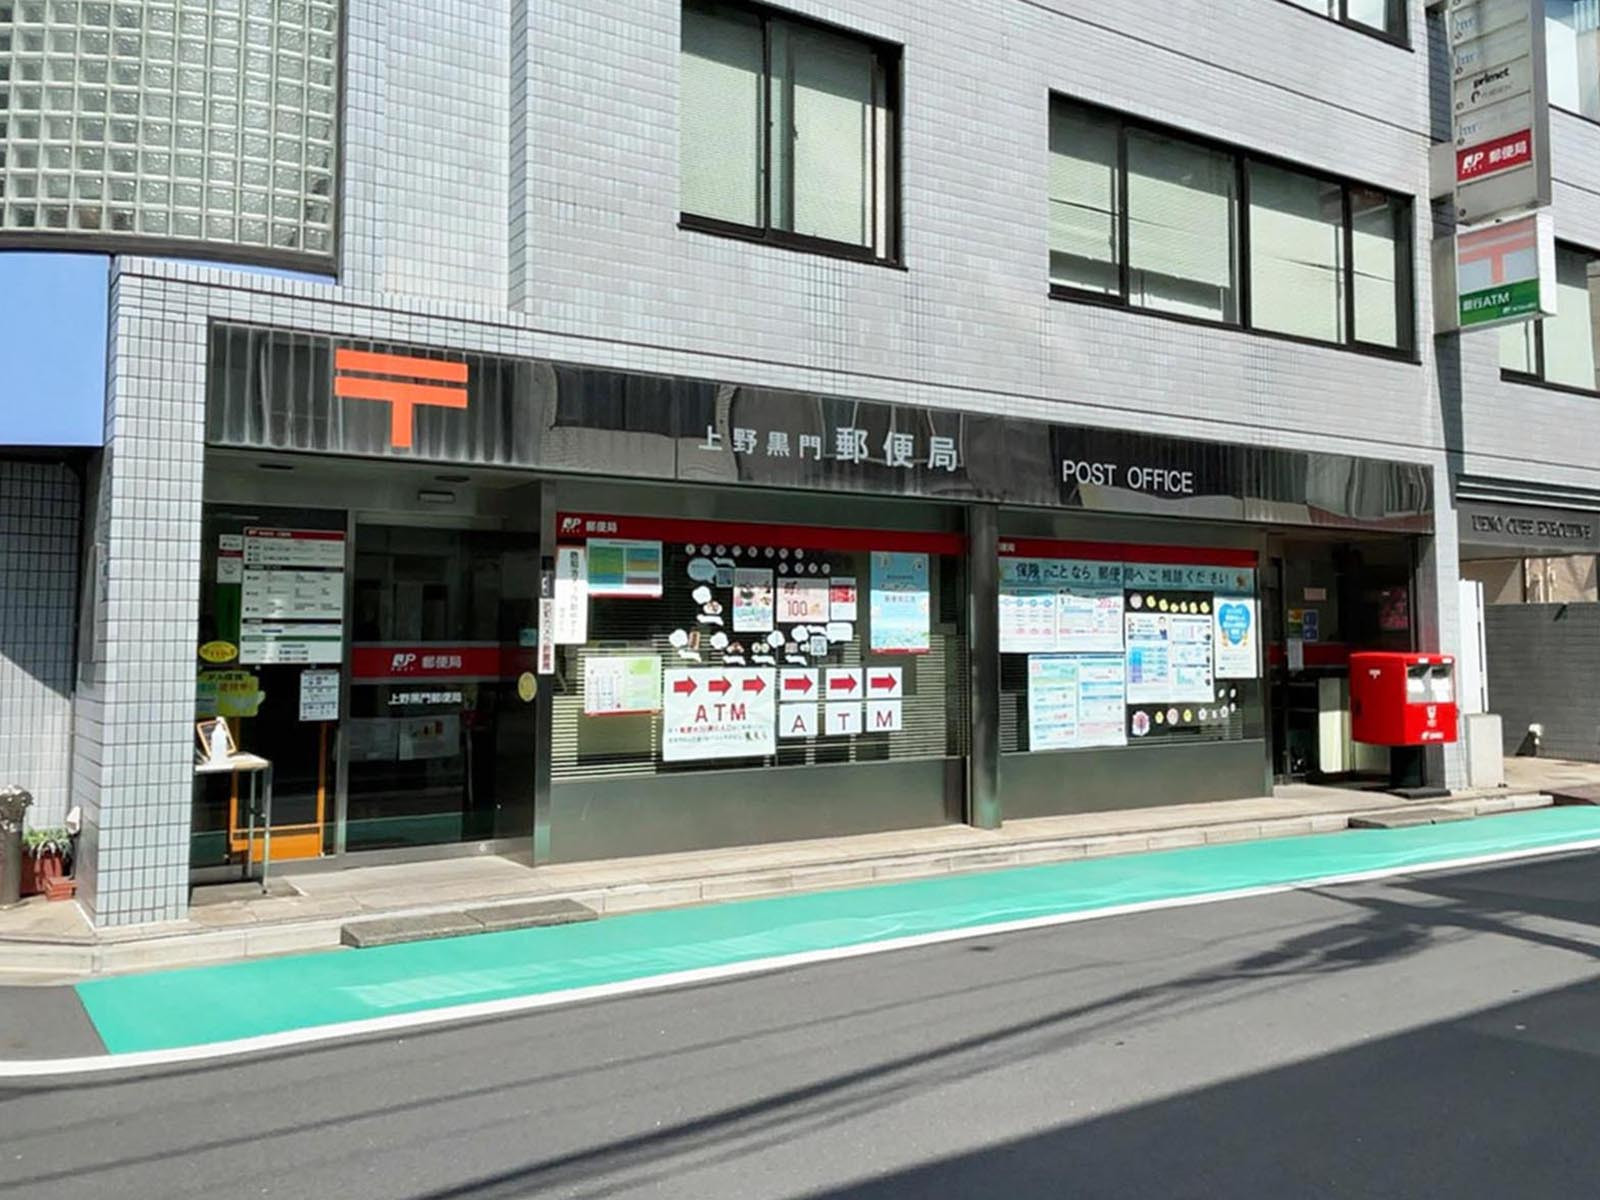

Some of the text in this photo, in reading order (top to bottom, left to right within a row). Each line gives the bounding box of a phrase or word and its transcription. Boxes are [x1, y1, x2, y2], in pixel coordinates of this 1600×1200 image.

[1488, 141, 1527, 164] 郵便局
[698, 425, 959, 472] 上野黒門郵便局
[1062, 459, 1193, 494] POST OFFICE
[695, 703, 747, 722] ATM
[791, 714, 807, 732] A
[837, 713, 851, 730] T
[875, 710, 893, 728] M
